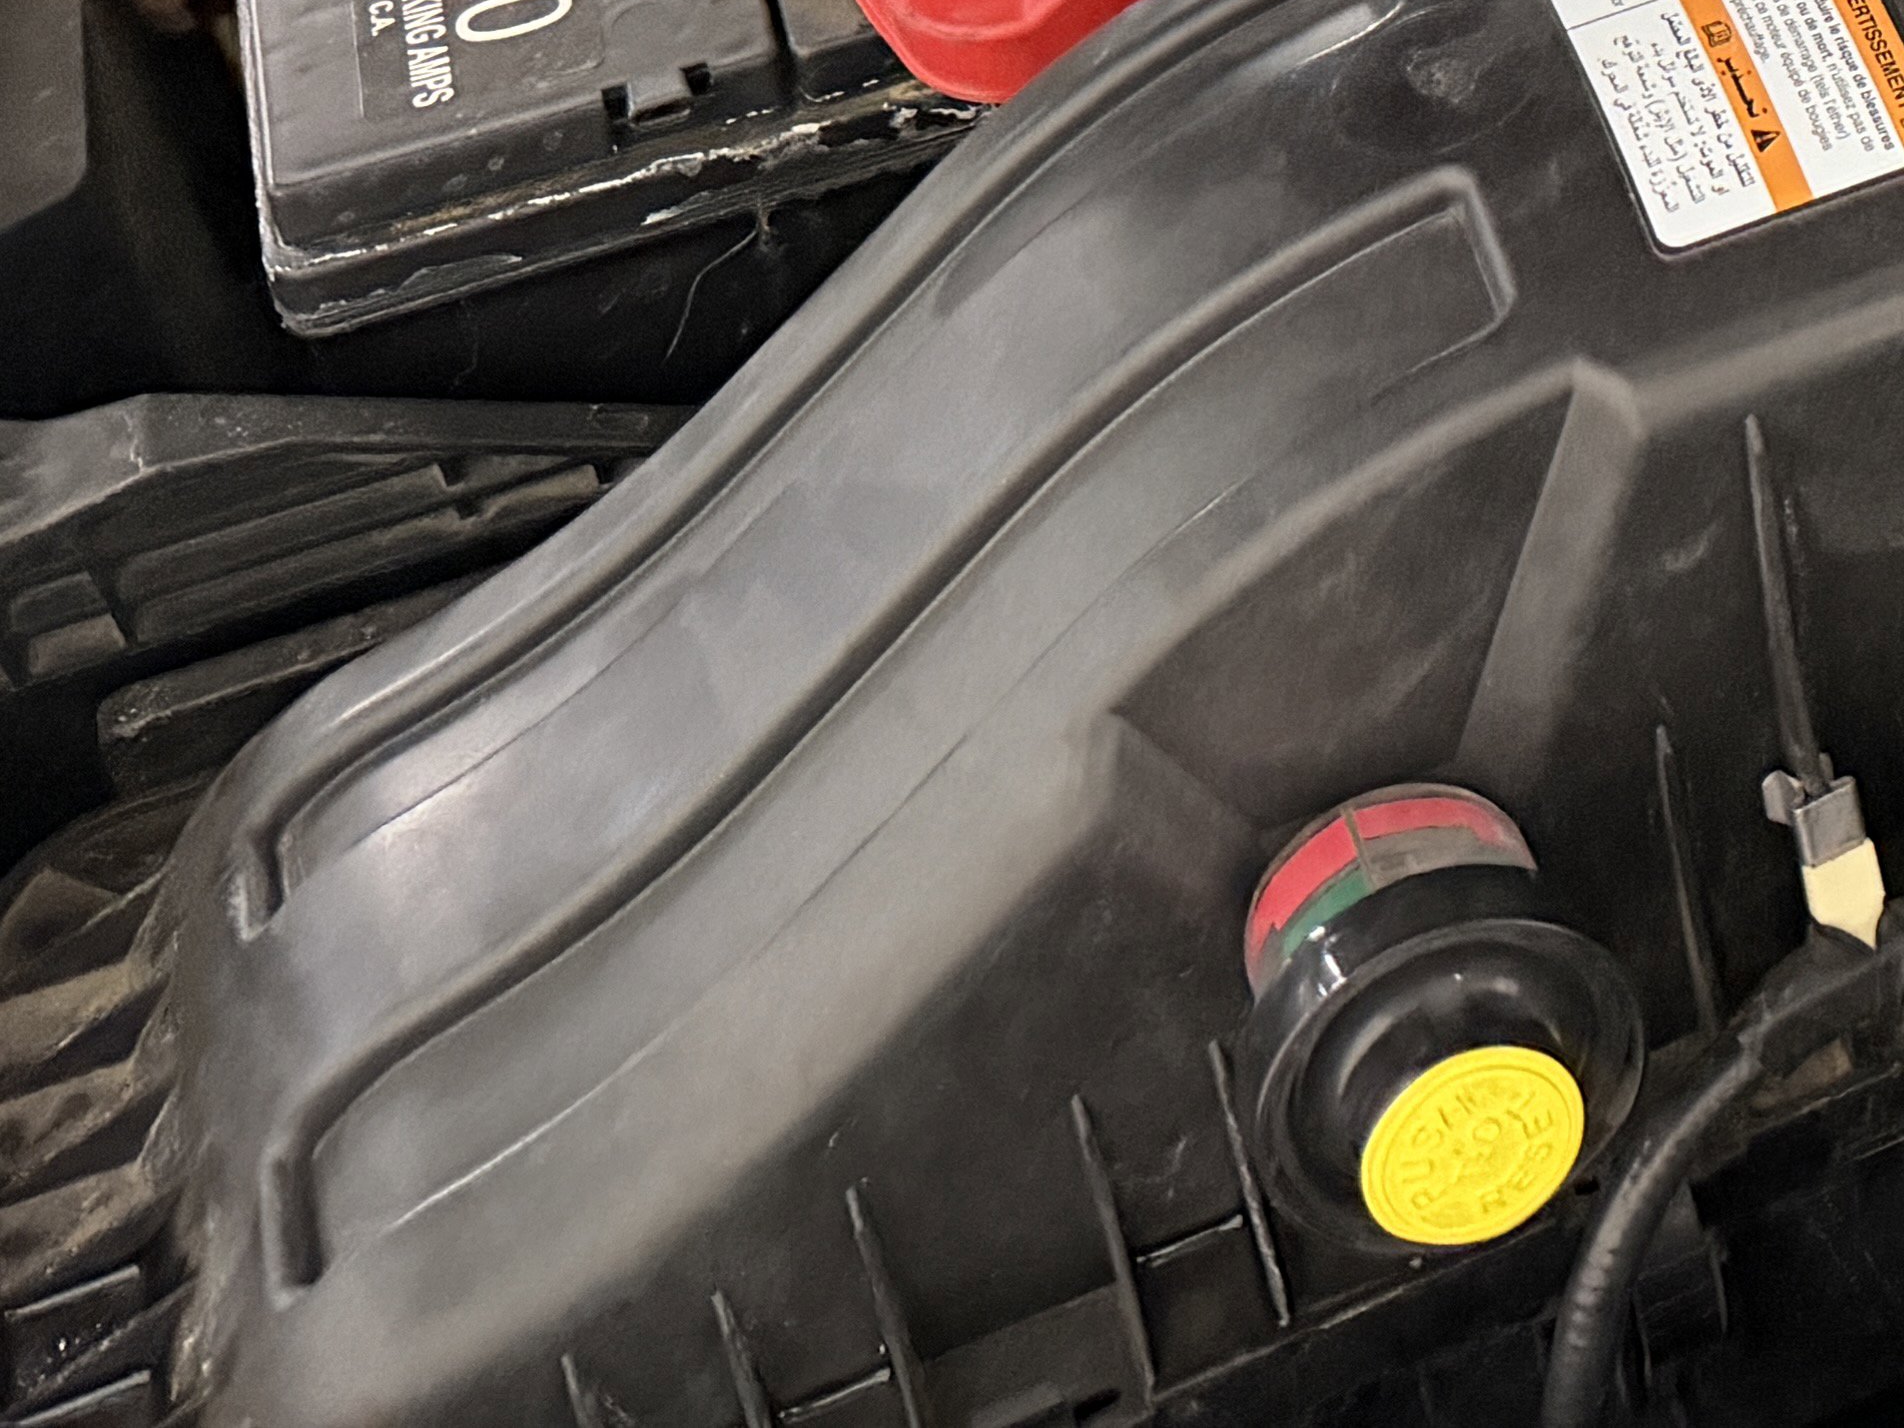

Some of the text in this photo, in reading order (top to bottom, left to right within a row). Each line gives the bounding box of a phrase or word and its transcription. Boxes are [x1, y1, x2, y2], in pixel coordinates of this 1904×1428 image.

[1804, 15, 1819, 31] de
[1828, 23, 1843, 35] le
[1831, 35, 1861, 73] risque
[407, 45, 455, 108] AMPS
[1852, 72, 1869, 89] de
[1857, 88, 1899, 151] blessures
